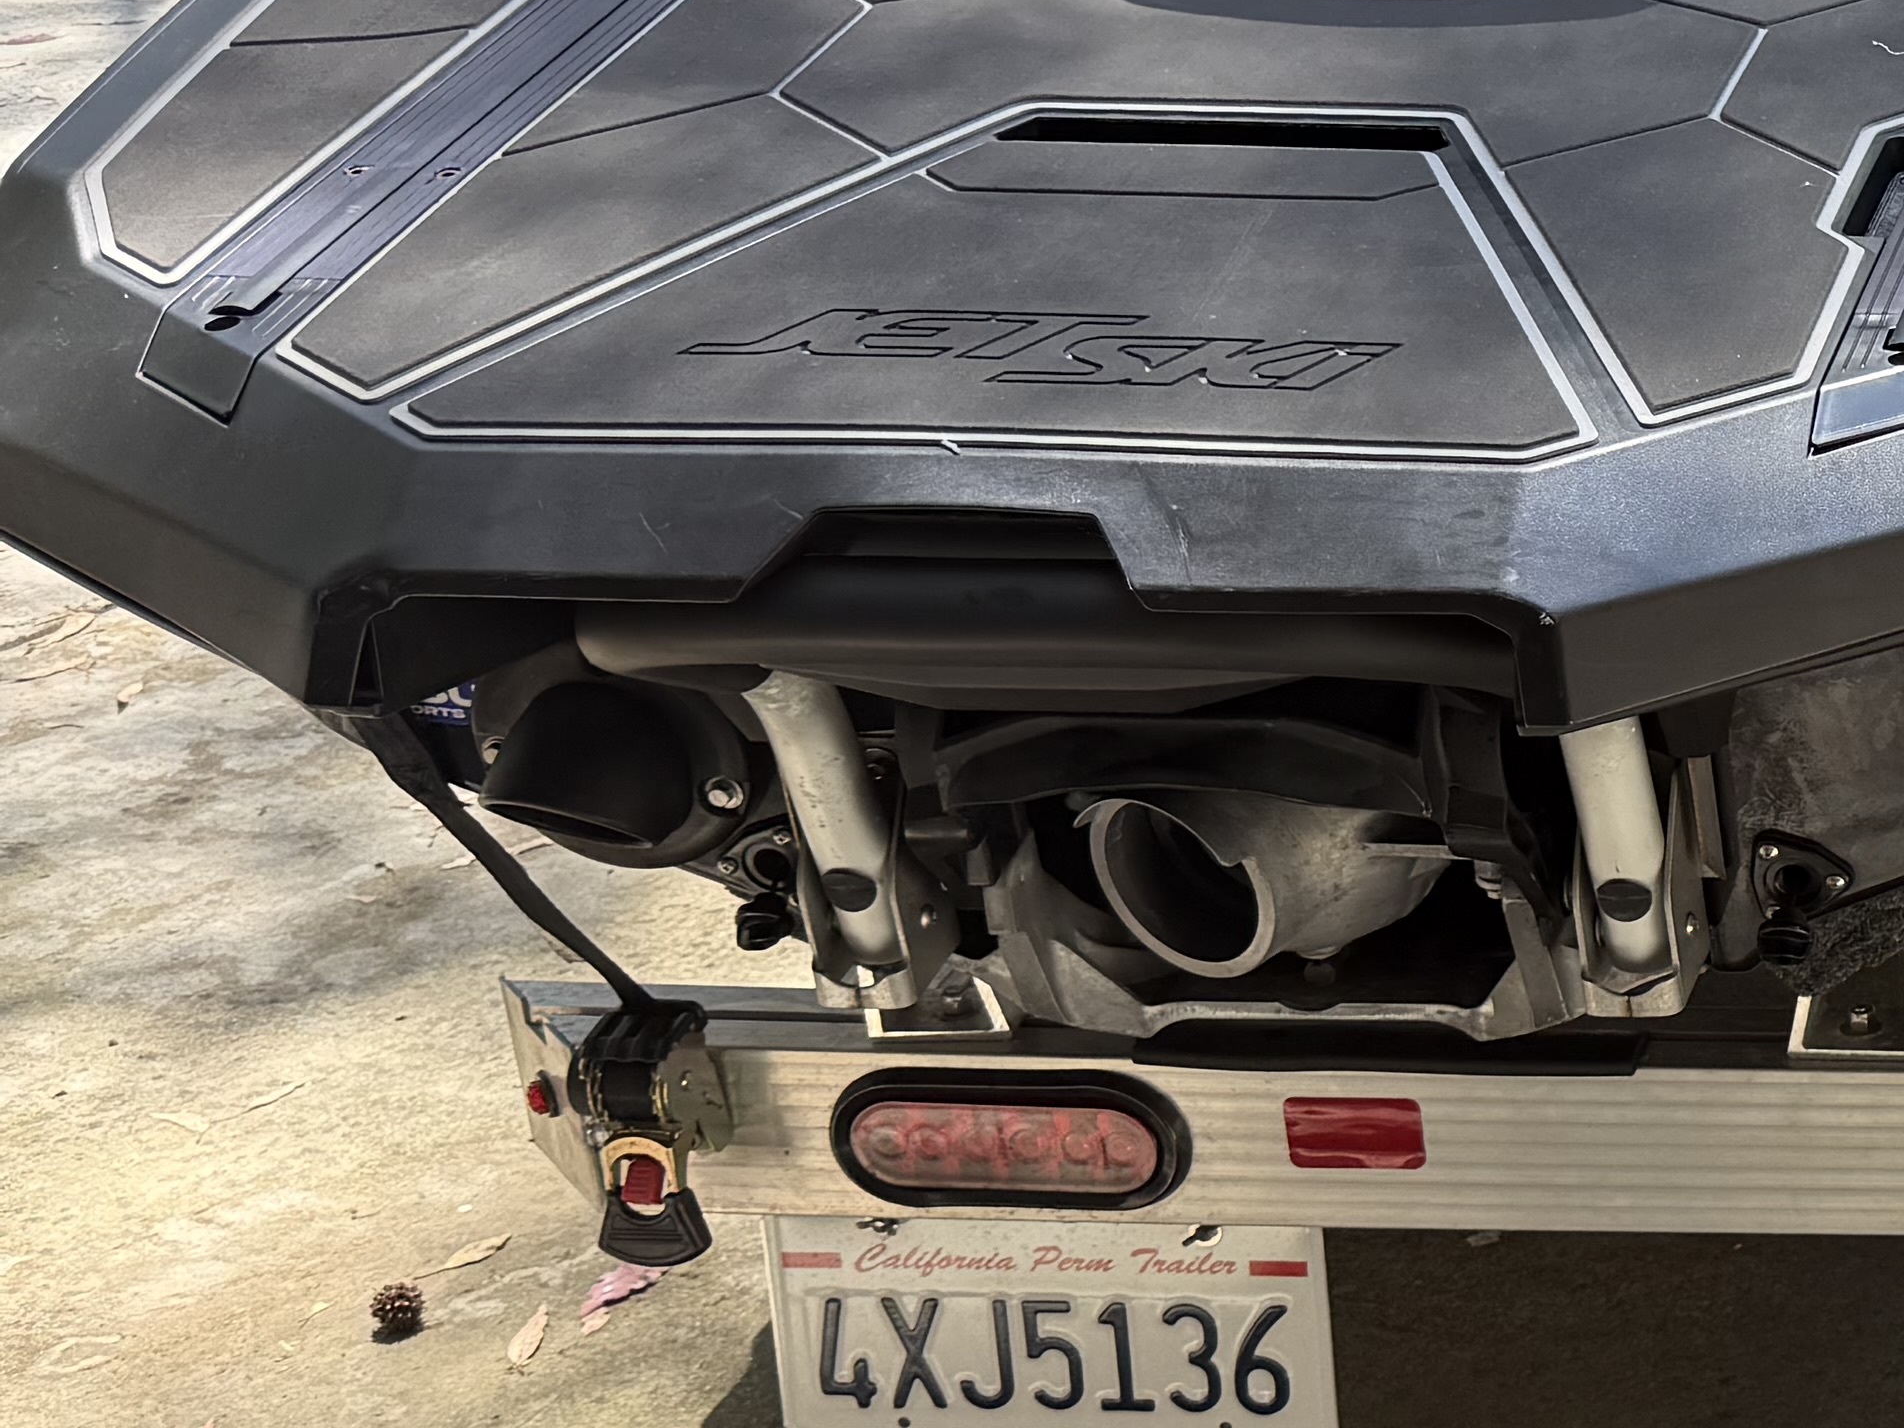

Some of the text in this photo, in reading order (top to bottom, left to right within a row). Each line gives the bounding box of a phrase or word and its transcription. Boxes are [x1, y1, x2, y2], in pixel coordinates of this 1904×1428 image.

[676, 309, 1404, 391] JET SKI
[854, 1241, 1239, 1277] California Perm Trailer
[820, 1297, 1291, 1416] 4XJ5136
